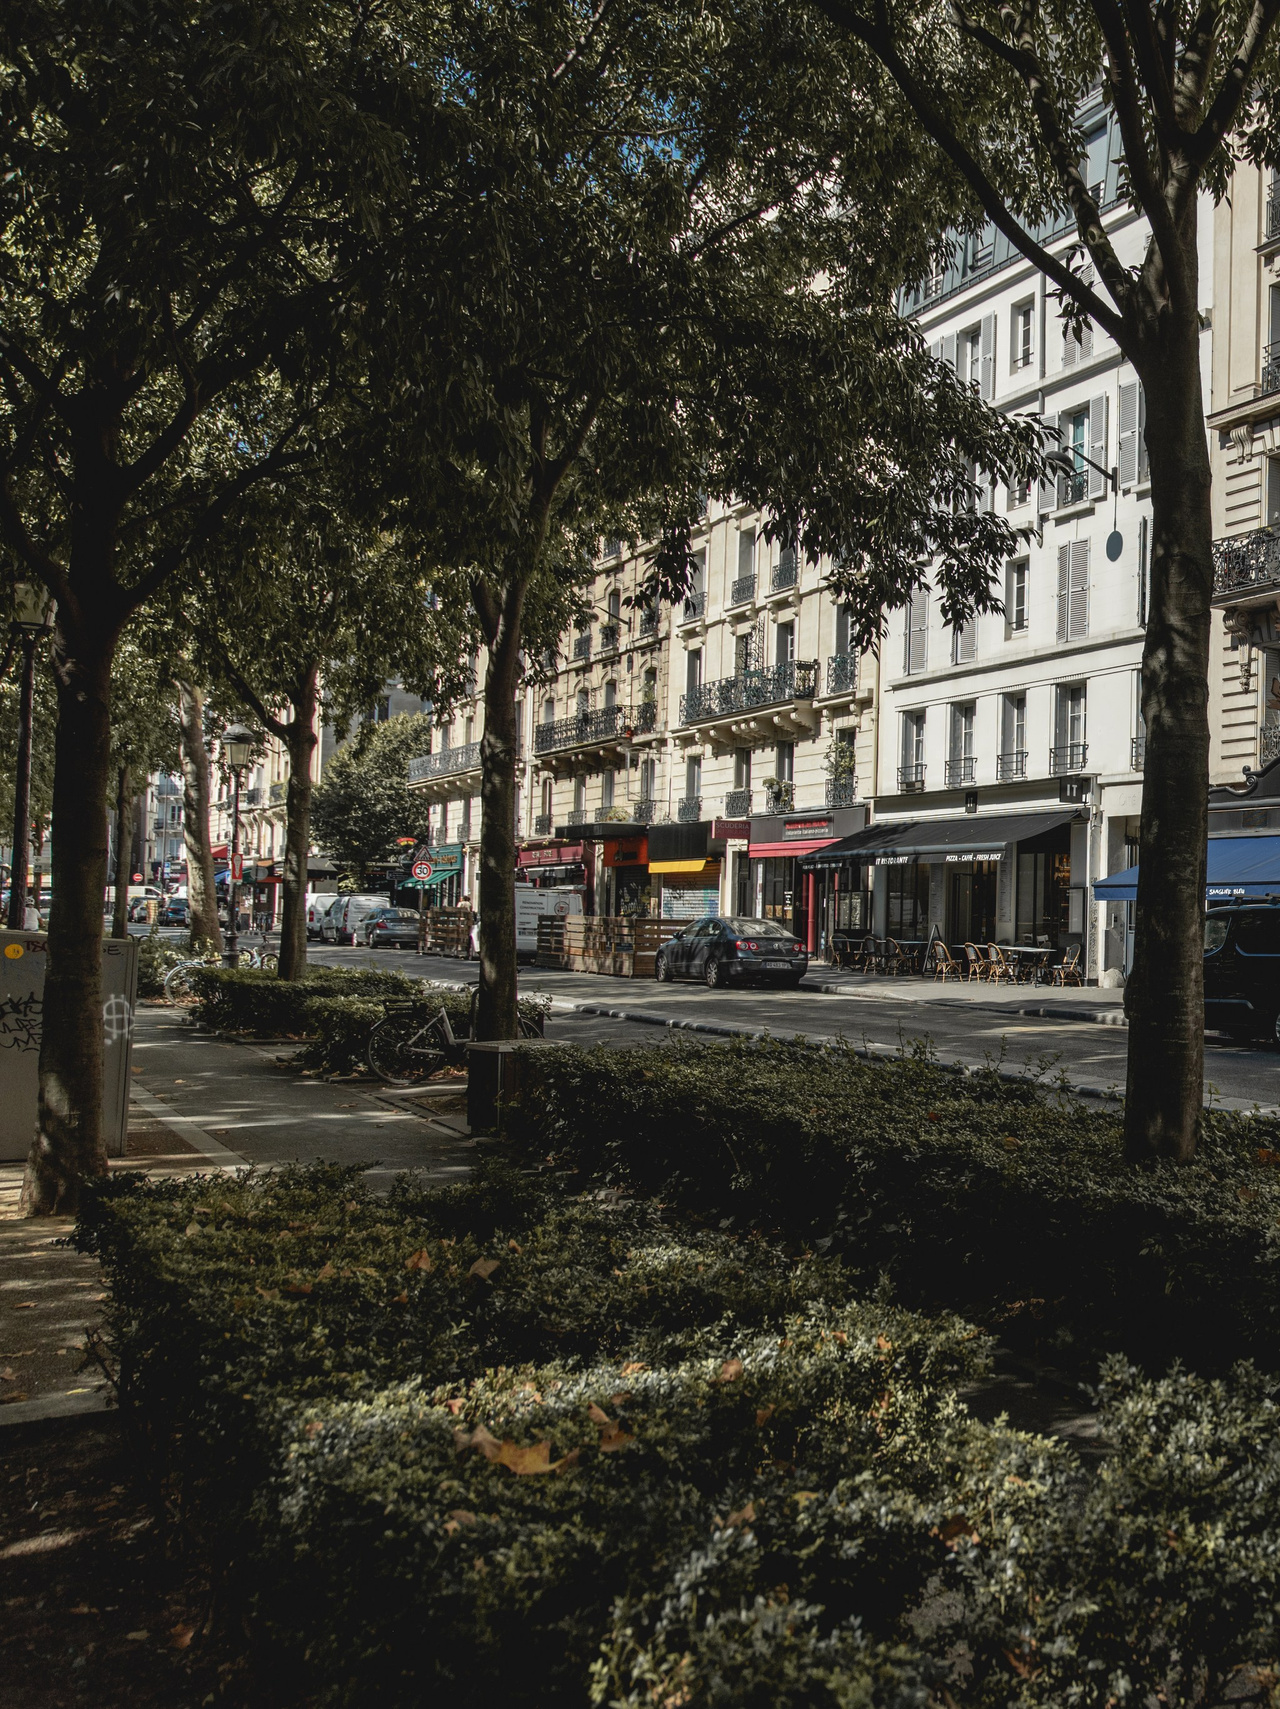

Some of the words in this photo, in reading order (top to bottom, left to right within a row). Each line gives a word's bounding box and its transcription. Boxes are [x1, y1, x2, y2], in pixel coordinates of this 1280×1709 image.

[1066, 783, 1078, 797] IT
[716, 822, 749, 830] SCUDERIA
[875, 857, 881, 866] IT
[881, 856, 909, 865] RISTORANTE
[989, 853, 1002, 861] JUICE
[417, 866, 429, 875] 30
